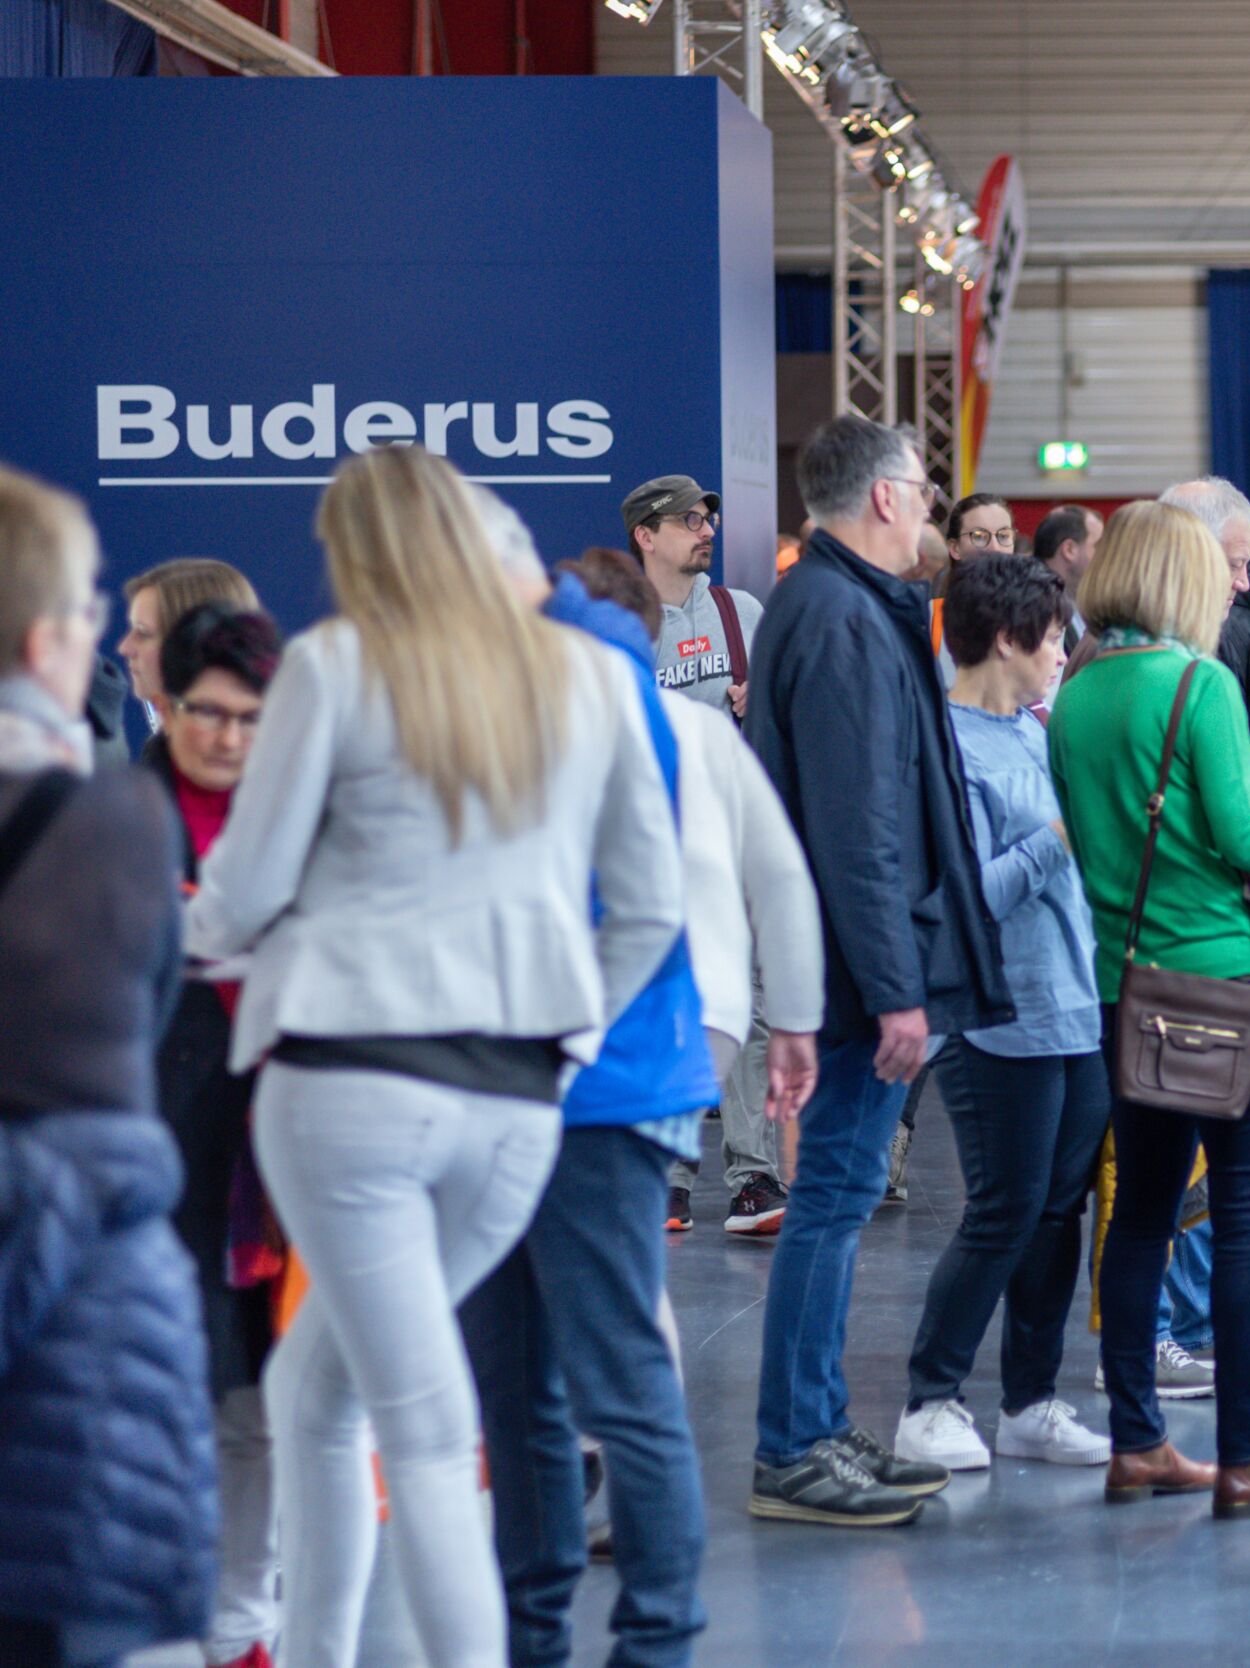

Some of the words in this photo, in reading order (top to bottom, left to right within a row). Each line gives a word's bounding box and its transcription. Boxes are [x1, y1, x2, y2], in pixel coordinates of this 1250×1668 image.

[96, 383, 614, 461] Buderus
[682, 639, 708, 654] Daly
[655, 660, 696, 688] FAKE
